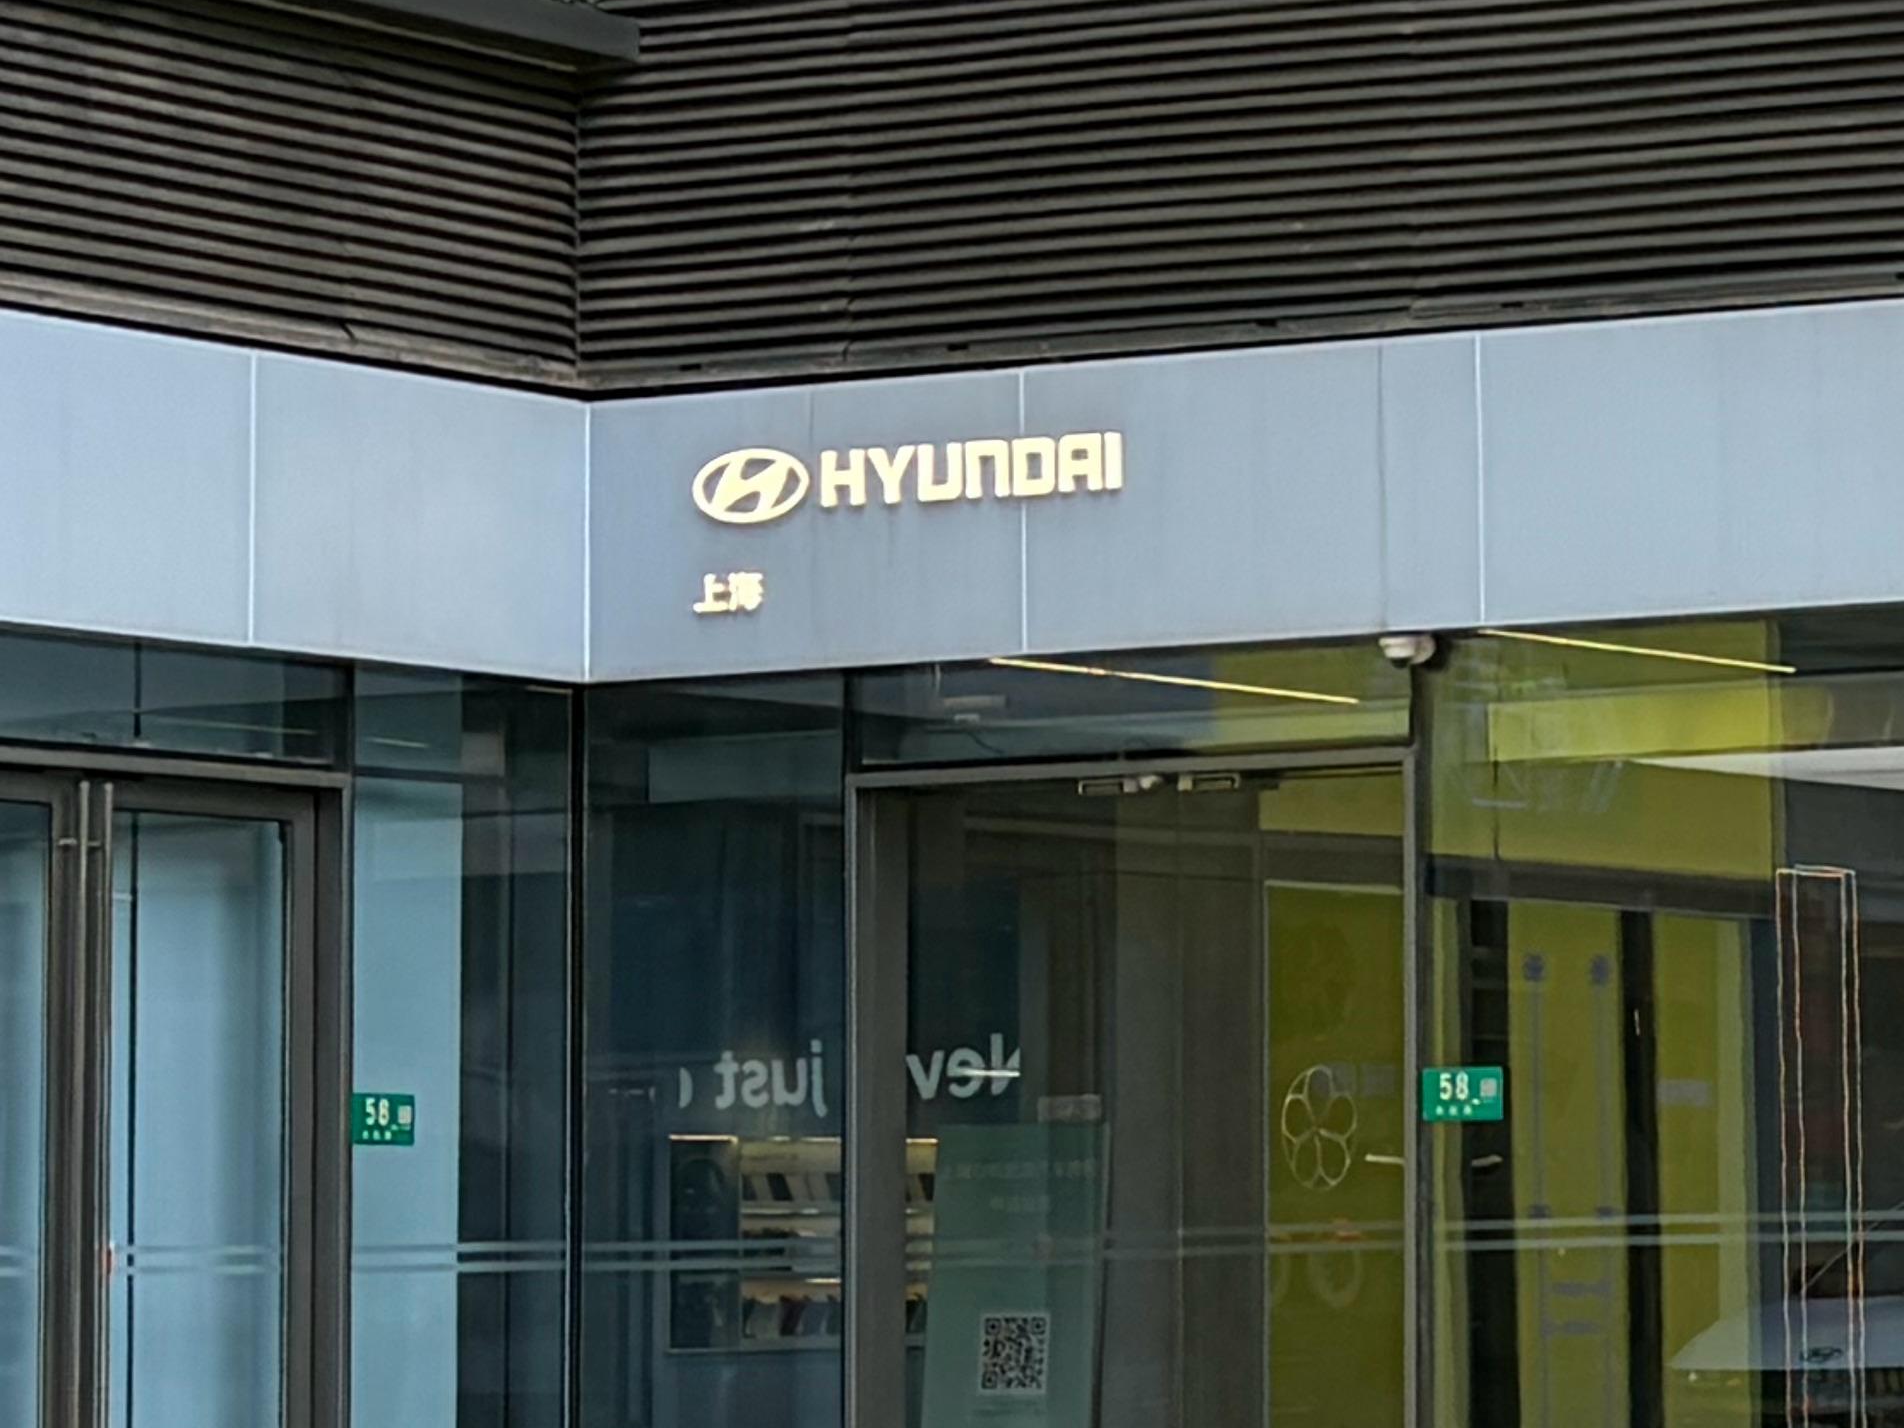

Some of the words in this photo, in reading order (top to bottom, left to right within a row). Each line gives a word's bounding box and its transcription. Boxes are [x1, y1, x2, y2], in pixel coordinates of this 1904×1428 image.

[819, 431, 1123, 507] HYUNDAI
[692, 571, 764, 613] 上海
[1439, 1072, 1470, 1101] 58
[365, 1098, 390, 1127] 58
